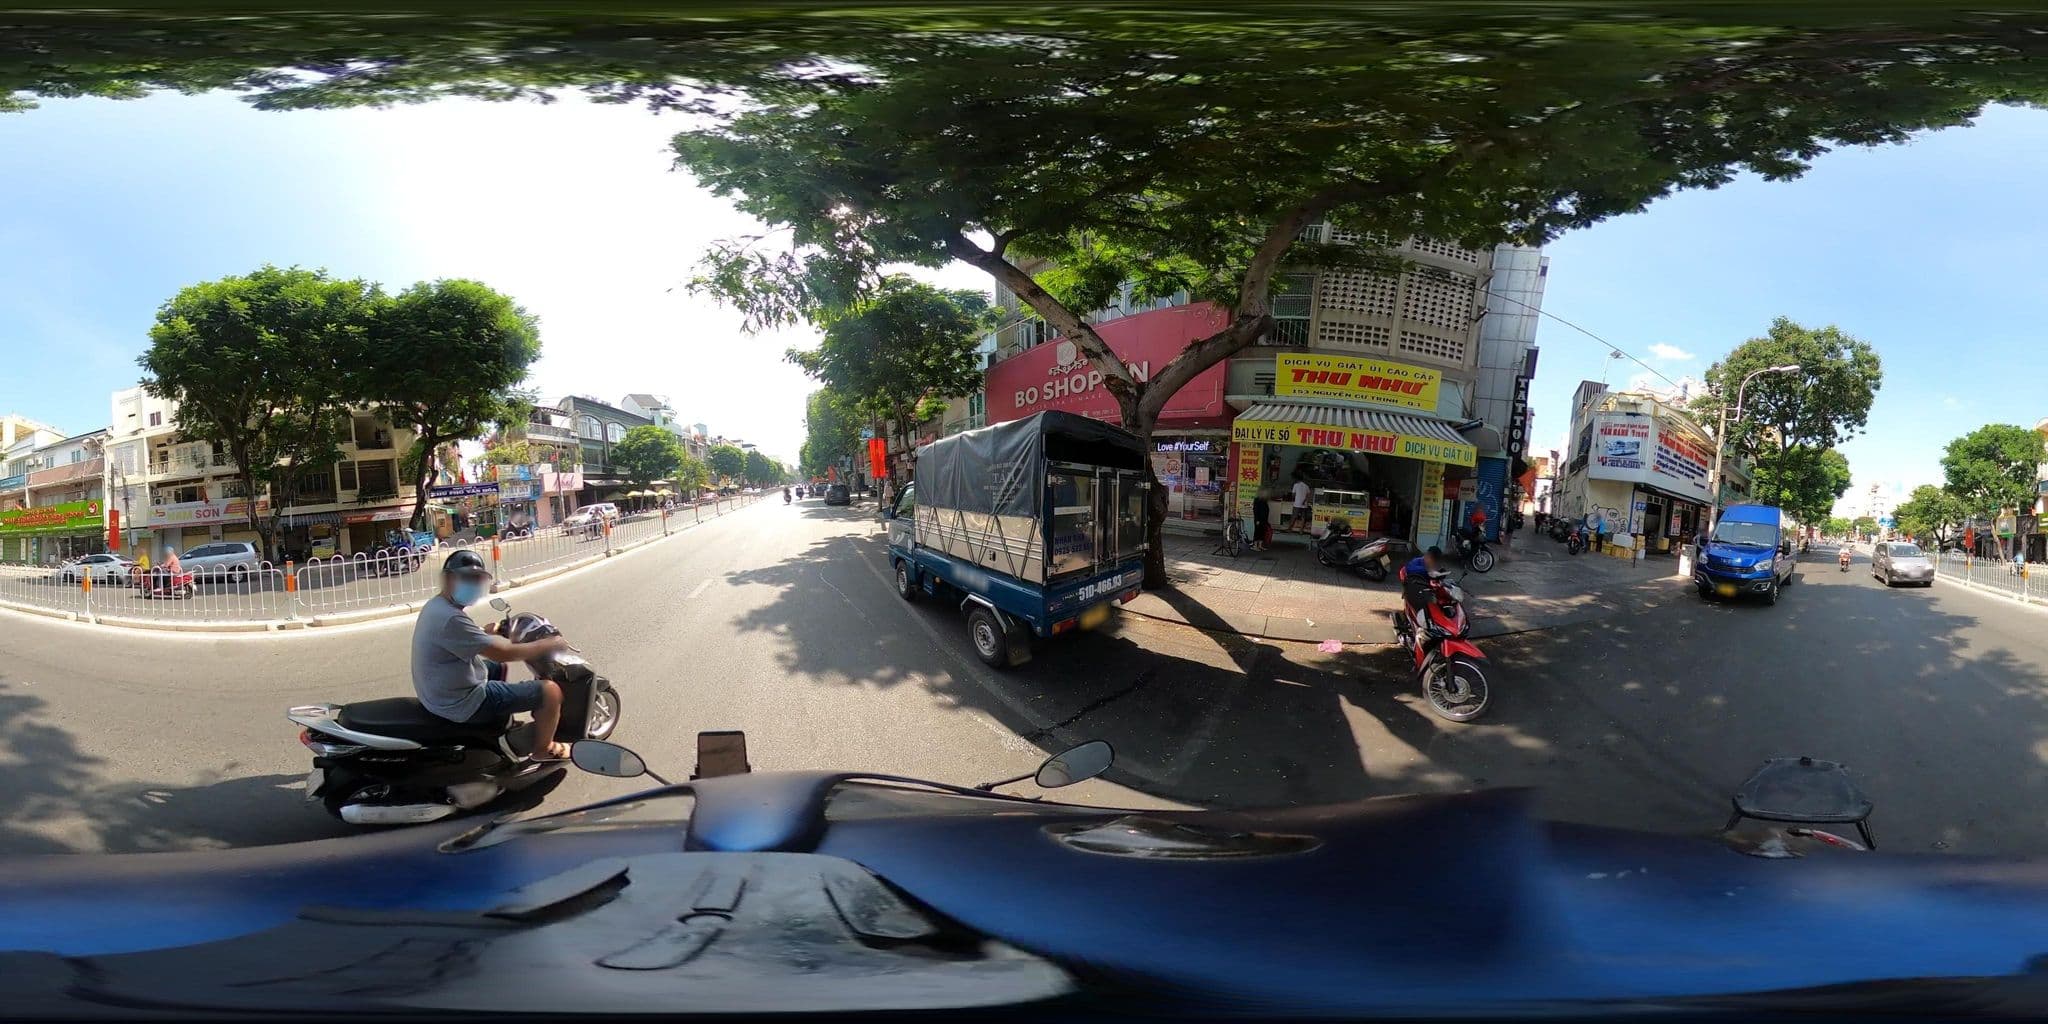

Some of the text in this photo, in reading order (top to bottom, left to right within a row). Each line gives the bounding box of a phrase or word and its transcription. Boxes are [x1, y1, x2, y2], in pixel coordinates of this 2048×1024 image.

[1387, 368, 1408, 377] CAO
[1291, 368, 1429, 396] THU NHƯ
[1015, 386, 1039, 409] BO
[1511, 378, 1528, 453] TATTOO
[1252, 425, 1262, 439] LÝ
[1157, 441, 1209, 452] Love #YourSelf
[1297, 428, 1399, 454] THU NHƯ
[1405, 441, 1426, 456] DỊCH
[195, 507, 220, 520] SƠN
